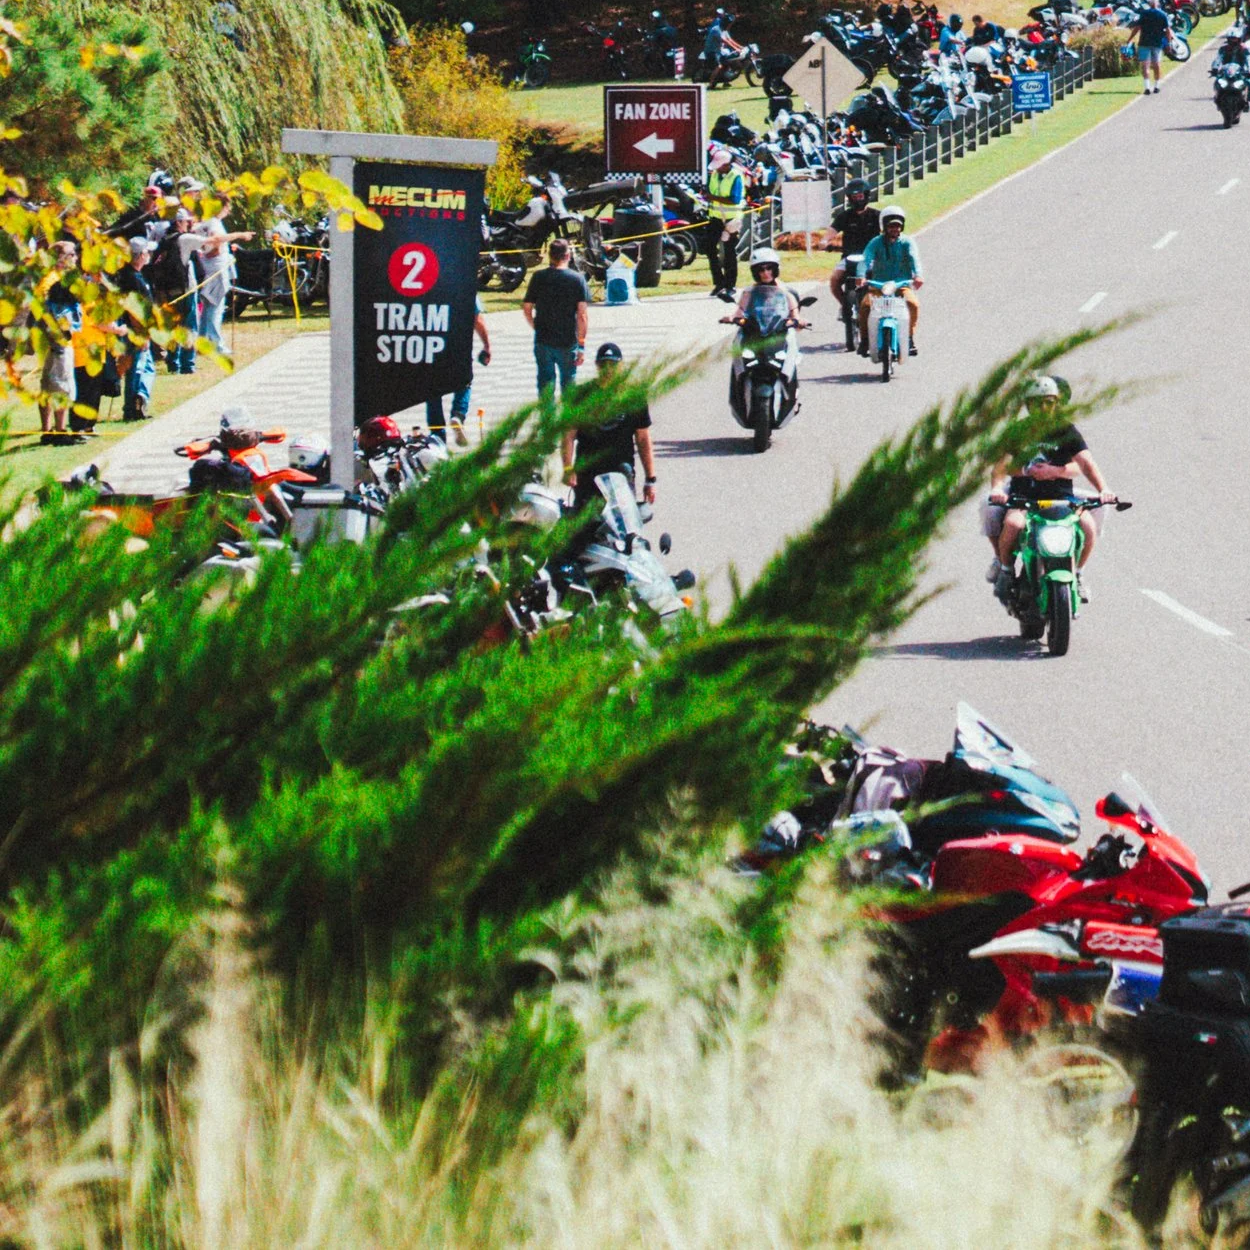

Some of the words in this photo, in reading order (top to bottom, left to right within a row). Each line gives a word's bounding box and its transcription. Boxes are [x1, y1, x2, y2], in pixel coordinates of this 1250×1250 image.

[614, 102, 646, 121] FAN
[649, 102, 691, 121] ZONE
[368, 184, 466, 210] MECUM
[400, 250, 426, 290] 2
[373, 302, 450, 333] TRAM
[376, 334, 445, 364] STOP
